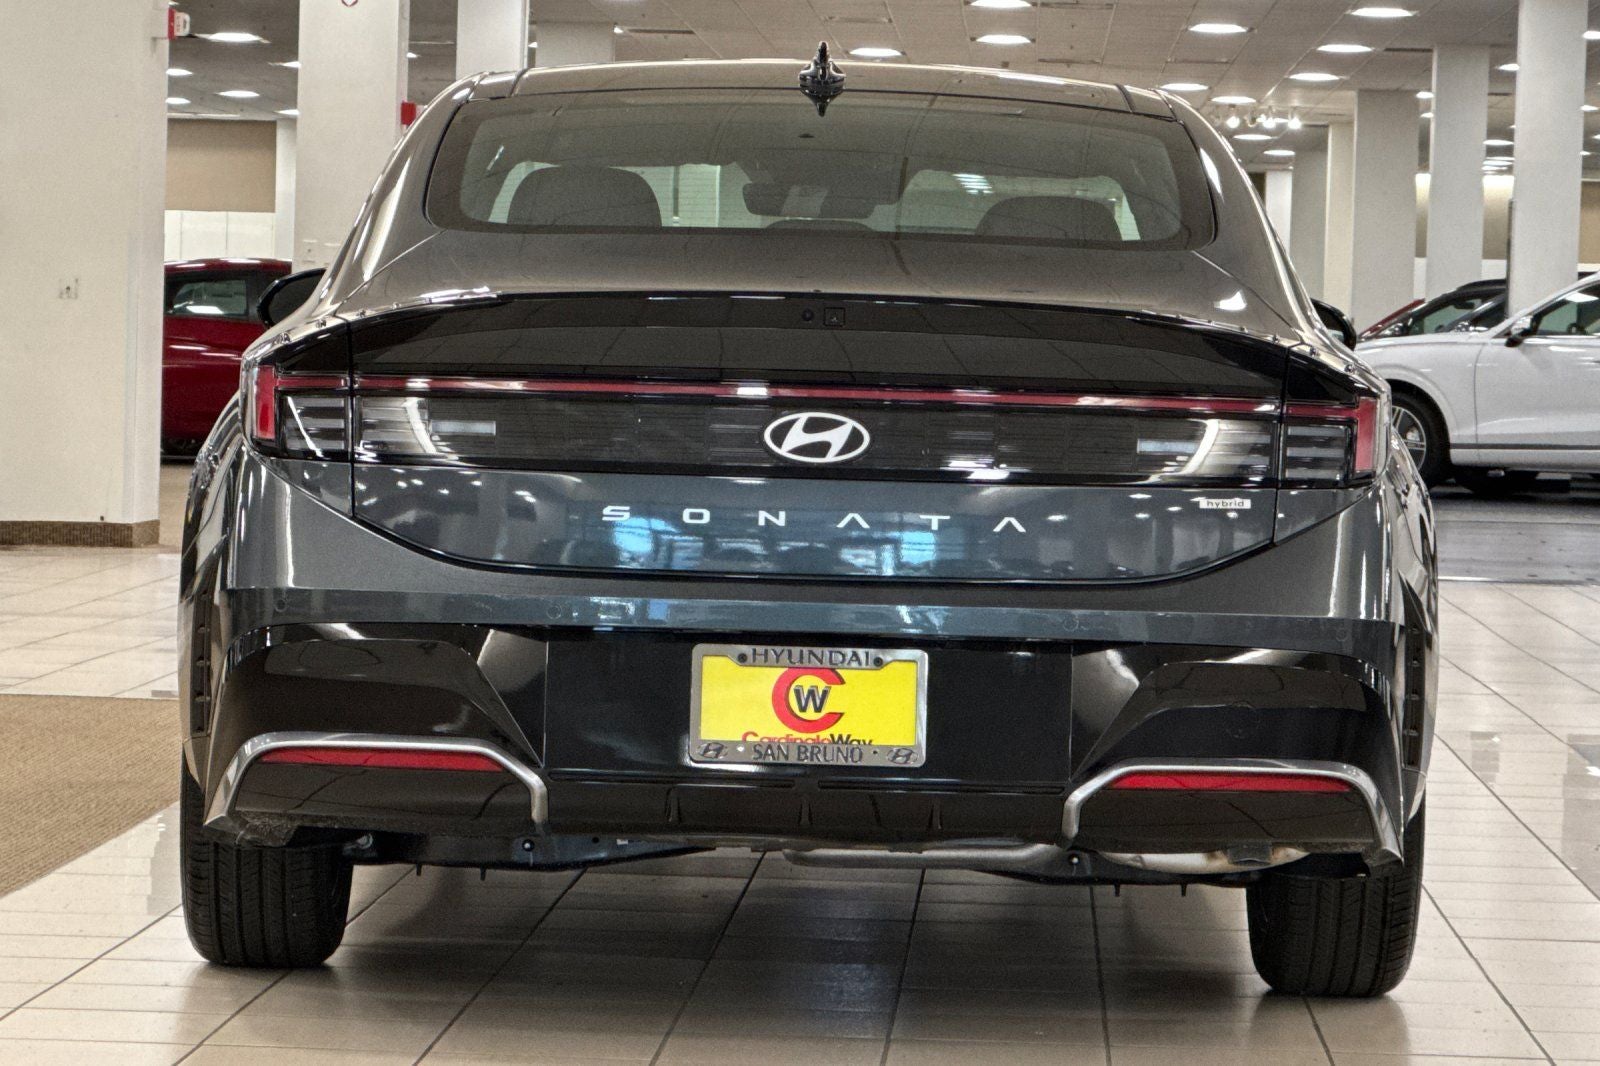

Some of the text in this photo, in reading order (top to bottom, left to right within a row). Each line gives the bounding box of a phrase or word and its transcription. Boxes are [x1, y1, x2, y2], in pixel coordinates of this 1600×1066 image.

[1206, 500, 1245, 508] hybrid
[602, 505, 1026, 533] SONATA
[752, 647, 870, 667] HYUNDAI
[753, 743, 863, 764] SAN BRUNO
